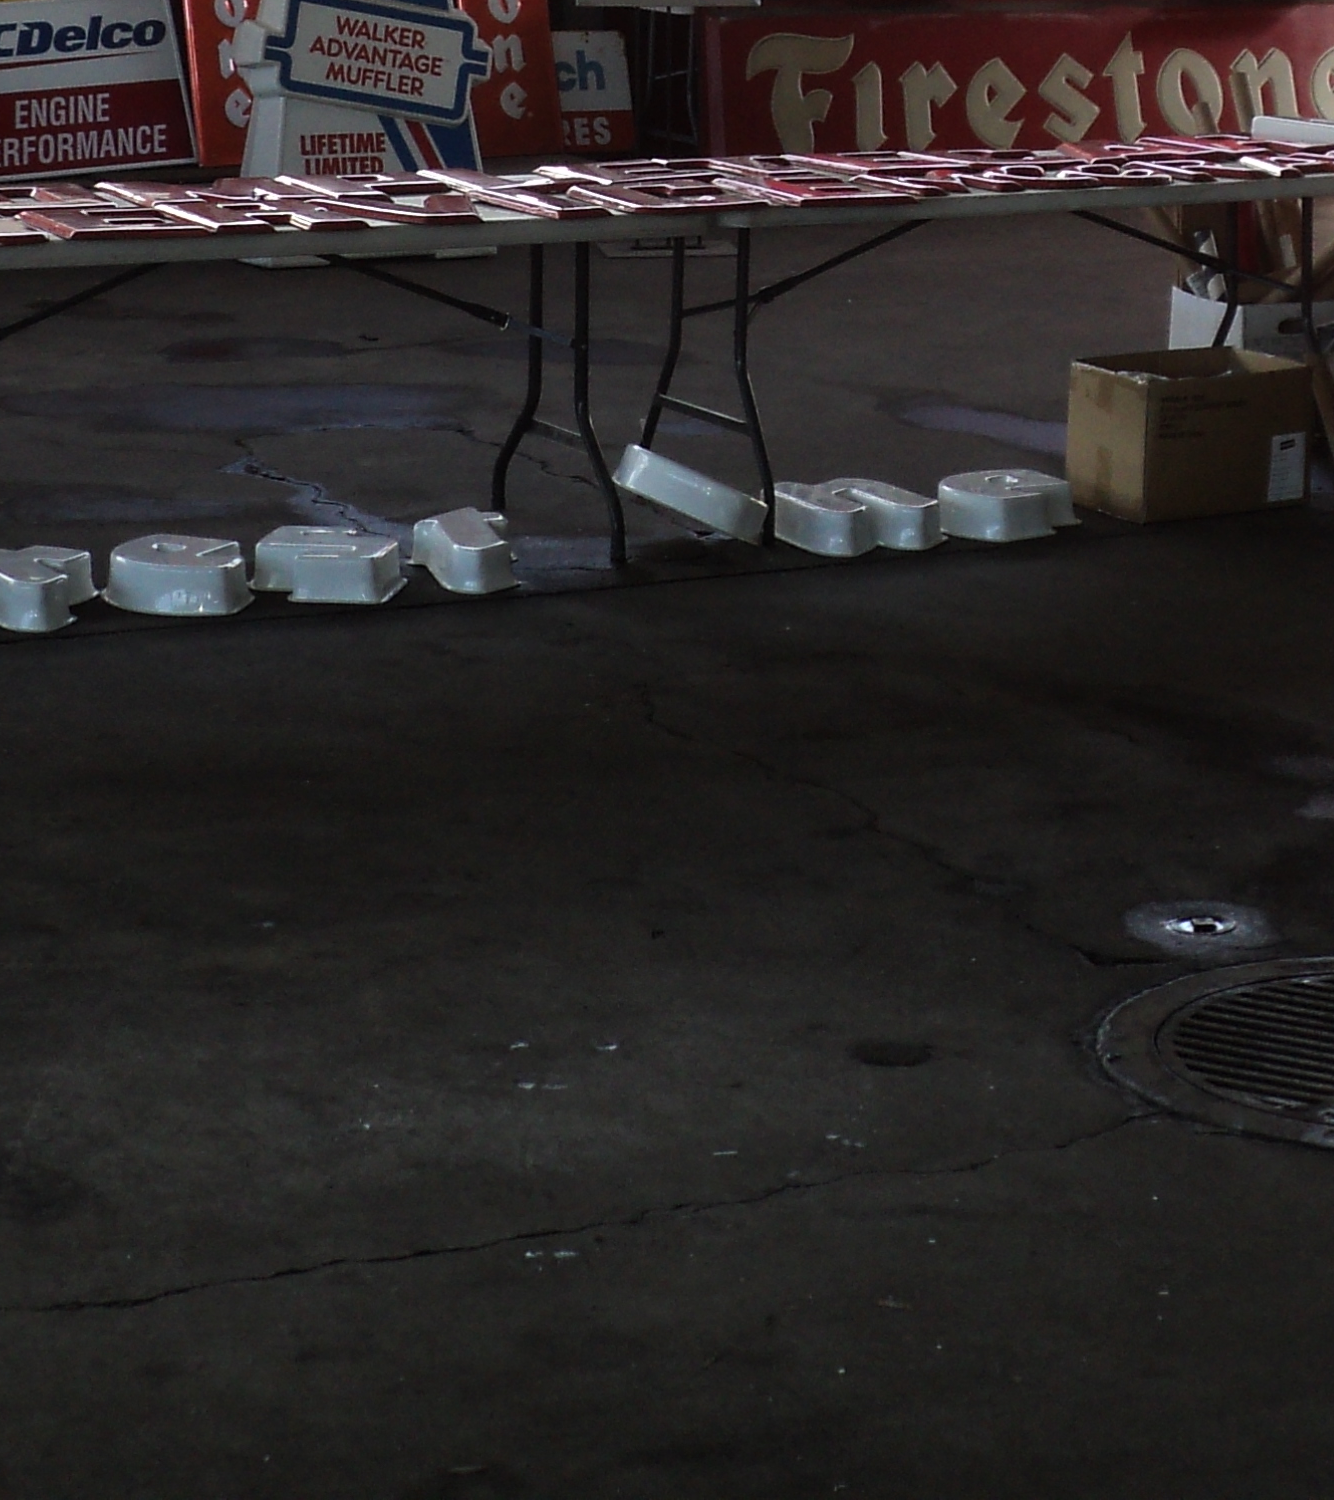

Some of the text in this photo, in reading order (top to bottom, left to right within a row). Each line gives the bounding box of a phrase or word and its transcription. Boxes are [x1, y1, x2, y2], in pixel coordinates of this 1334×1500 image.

[336, 16, 426, 50] WALKER
[309, 36, 443, 76] ADVANTAGE
[325, 62, 425, 98] MUFFLER
[14, 93, 111, 130] ENGINE
[300, 133, 386, 157] LIFETIME
[305, 157, 384, 176] LIMITED
